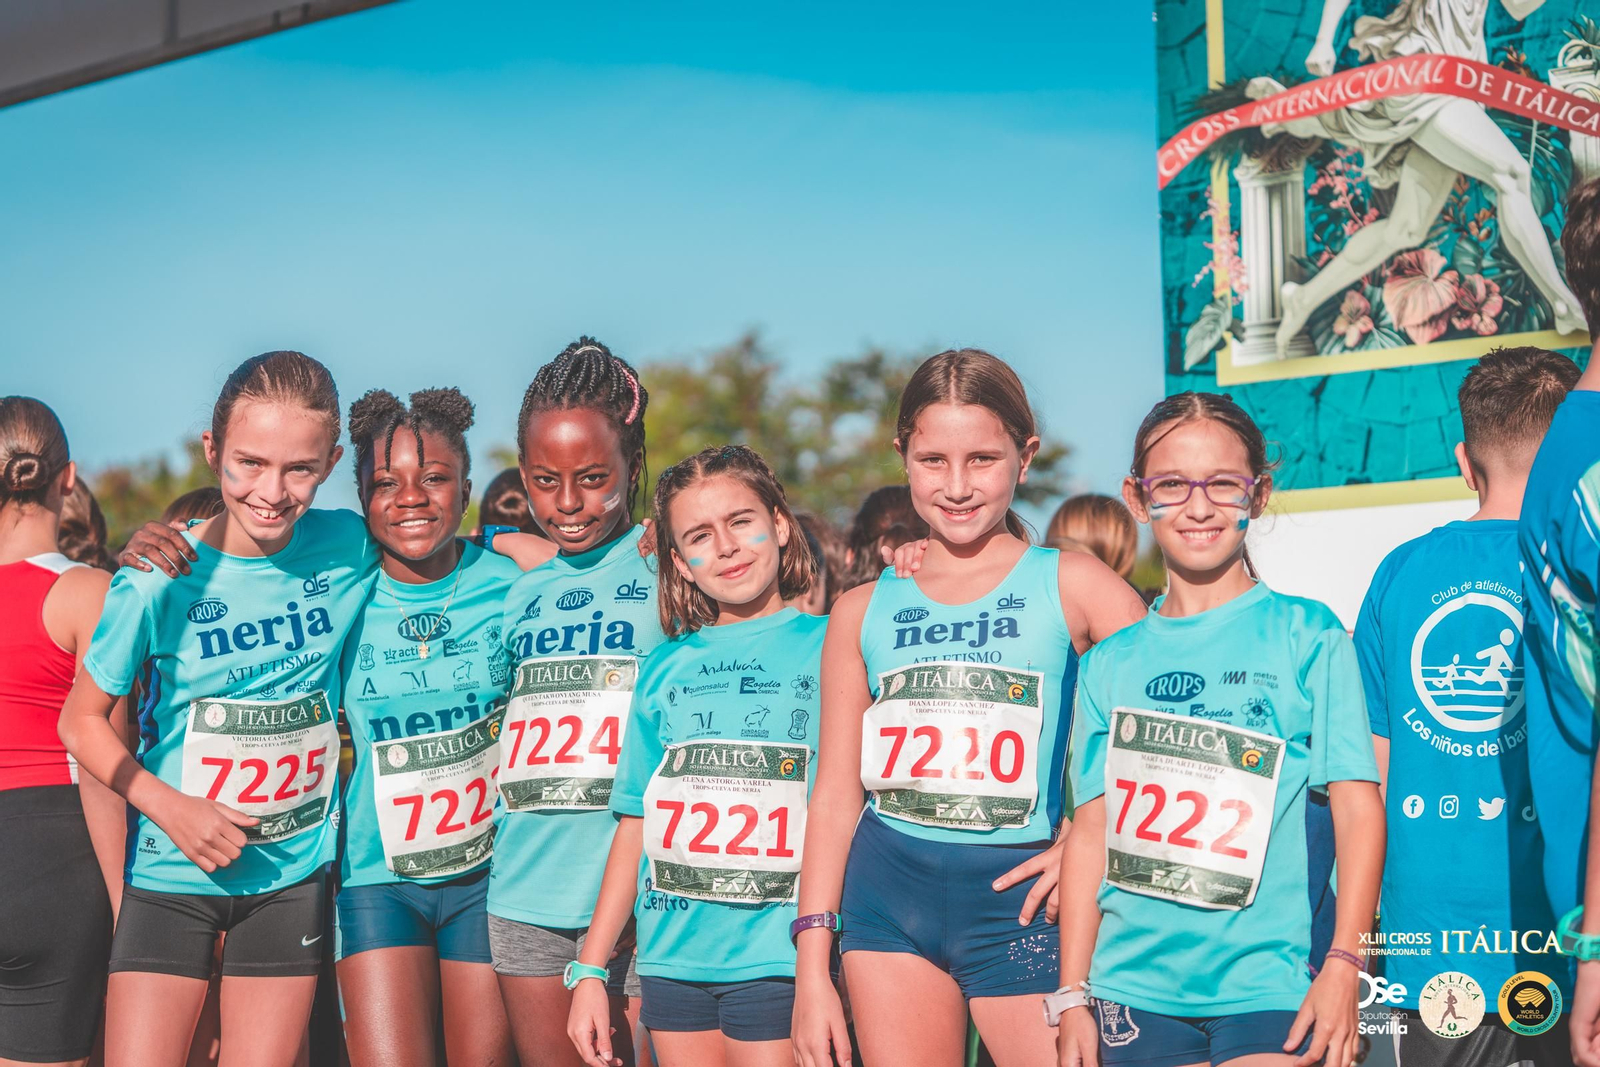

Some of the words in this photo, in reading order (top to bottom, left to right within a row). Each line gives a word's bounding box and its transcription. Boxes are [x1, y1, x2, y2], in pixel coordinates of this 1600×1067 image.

[1159, 108, 1240, 178] CROSS
[1251, 58, 1444, 123] INTERNACIONAL
[1455, 65, 1492, 97] DE
[1502, 80, 1600, 132] ITÁLICA
[557, 592, 592, 608] TROPS
[1431, 585, 1459, 605] Club
[1461, 581, 1472, 593] de
[1475, 580, 1523, 604] atletismo
[189, 602, 227, 620] TROPS
[895, 609, 928, 622] TROPS
[196, 601, 333, 659] nerja
[400, 615, 450, 636] TROPS
[516, 611, 635, 661] nerja
[893, 611, 1021, 649] nerja
[226, 652, 322, 685] ATLETISMO
[529, 663, 593, 683] ITÁLICA
[698, 658, 766, 677] Andalucía
[911, 667, 995, 691] ITÁLICA
[1253, 672, 1278, 681] metro
[743, 677, 781, 688] Rogelio
[1148, 673, 1203, 697] TROPS
[238, 704, 308, 725] ITÁLICA
[369, 693, 501, 742] nerj
[417, 729, 484, 760] ITÁLICA
[508, 715, 621, 769] 7224
[1143, 722, 1230, 754] ITÁLICA
[1402, 707, 1431, 741] Los
[1431, 733, 1473, 757] niños
[1476, 738, 1504, 757] del
[1505, 722, 1528, 748] bar
[690, 745, 769, 768] ITÁLICA
[879, 725, 1025, 783] 7220
[201, 747, 327, 803] 7225
[393, 765, 499, 841] 722
[936, 803, 988, 820] FAA
[656, 800, 794, 857] 7221
[1115, 779, 1253, 859] 7222
[712, 878, 762, 894] FAA
[644, 892, 689, 911] Centro
